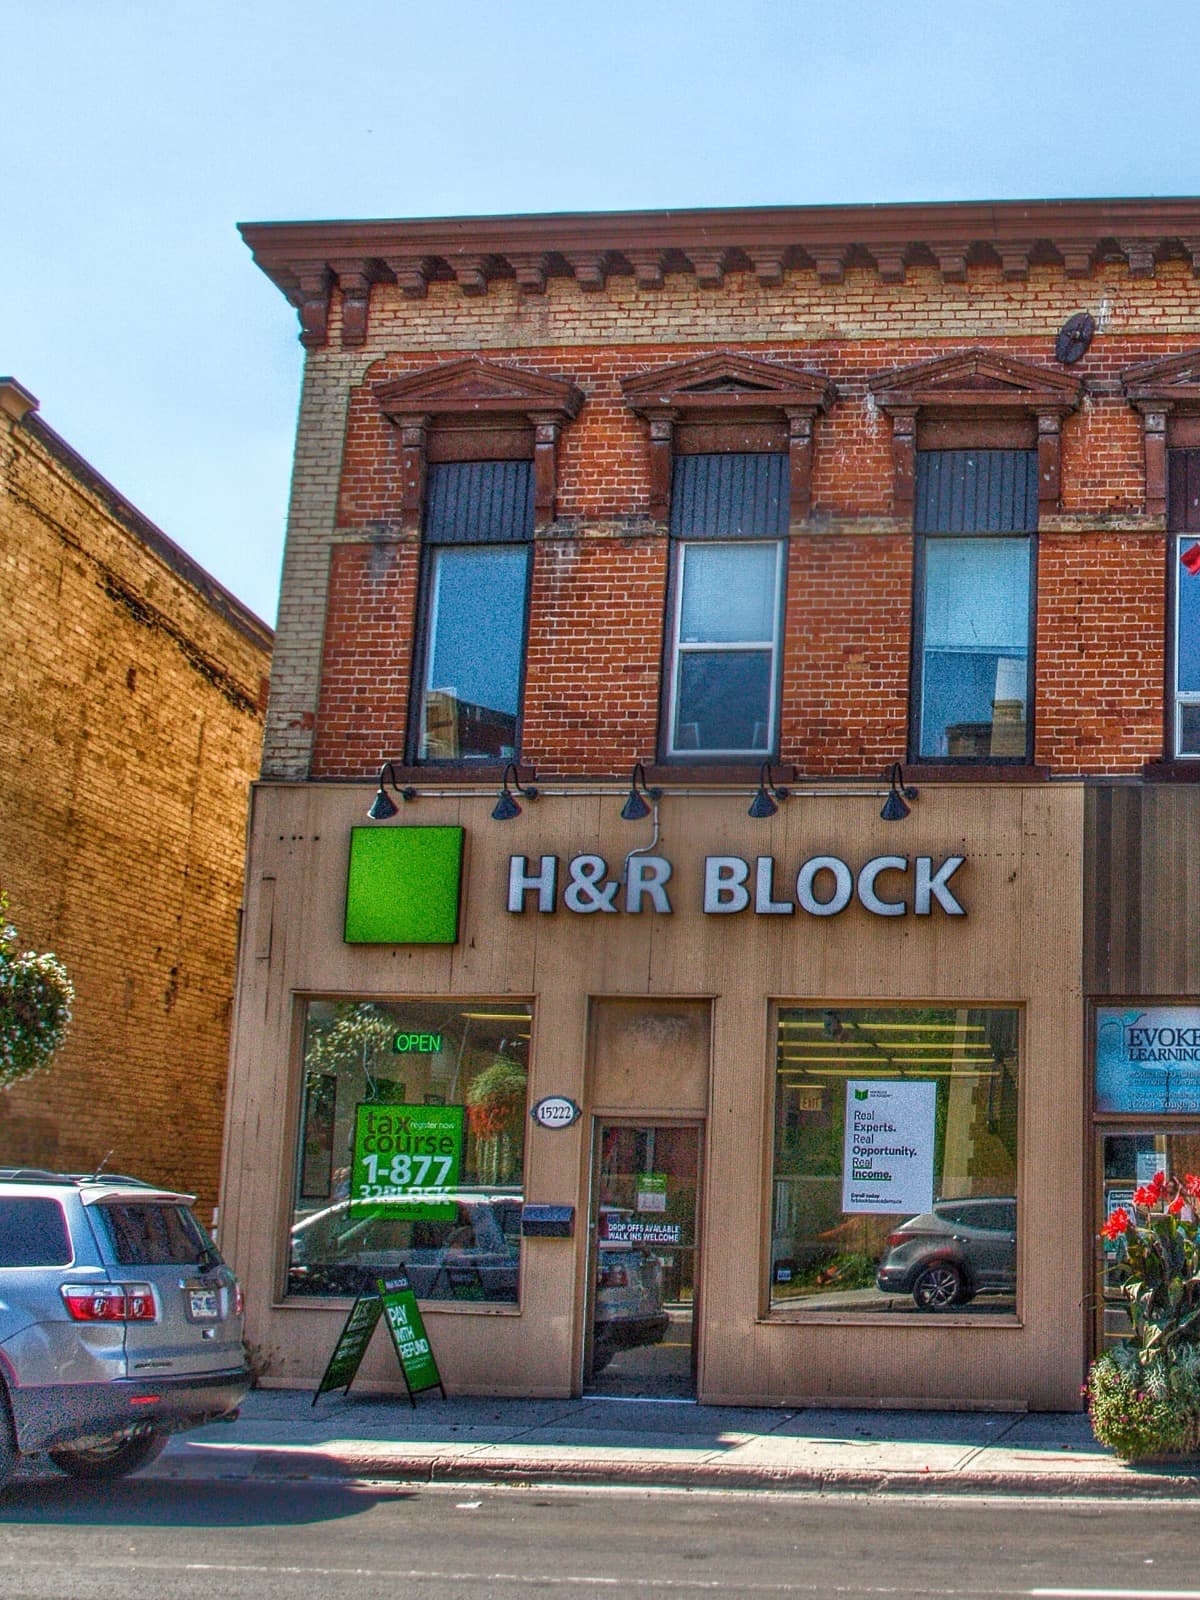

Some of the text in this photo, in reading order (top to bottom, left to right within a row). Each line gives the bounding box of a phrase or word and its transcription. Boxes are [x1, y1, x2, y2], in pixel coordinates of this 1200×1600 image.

[506, 854, 967, 916] H&R BLOCK
[396, 1034, 441, 1051] OPEN
[541, 1106, 571, 1119] 15222
[855, 1110, 875, 1121] Real
[366, 1111, 411, 1135] tax
[854, 1122, 897, 1133] Experts.
[363, 1134, 454, 1153] course
[854, 1134, 874, 1144] Real
[852, 1146, 917, 1158] Opportunity.
[853, 1157, 872, 1167] Real
[361, 1154, 453, 1185] 1-877
[852, 1170, 892, 1180] Income.
[608, 1224, 680, 1233] DROP OFFS AVAILABLE
[608, 1232, 680, 1242] WALK INS WELCOME
[388, 1304, 408, 1328] PAY
[399, 1338, 429, 1360] REFUND
